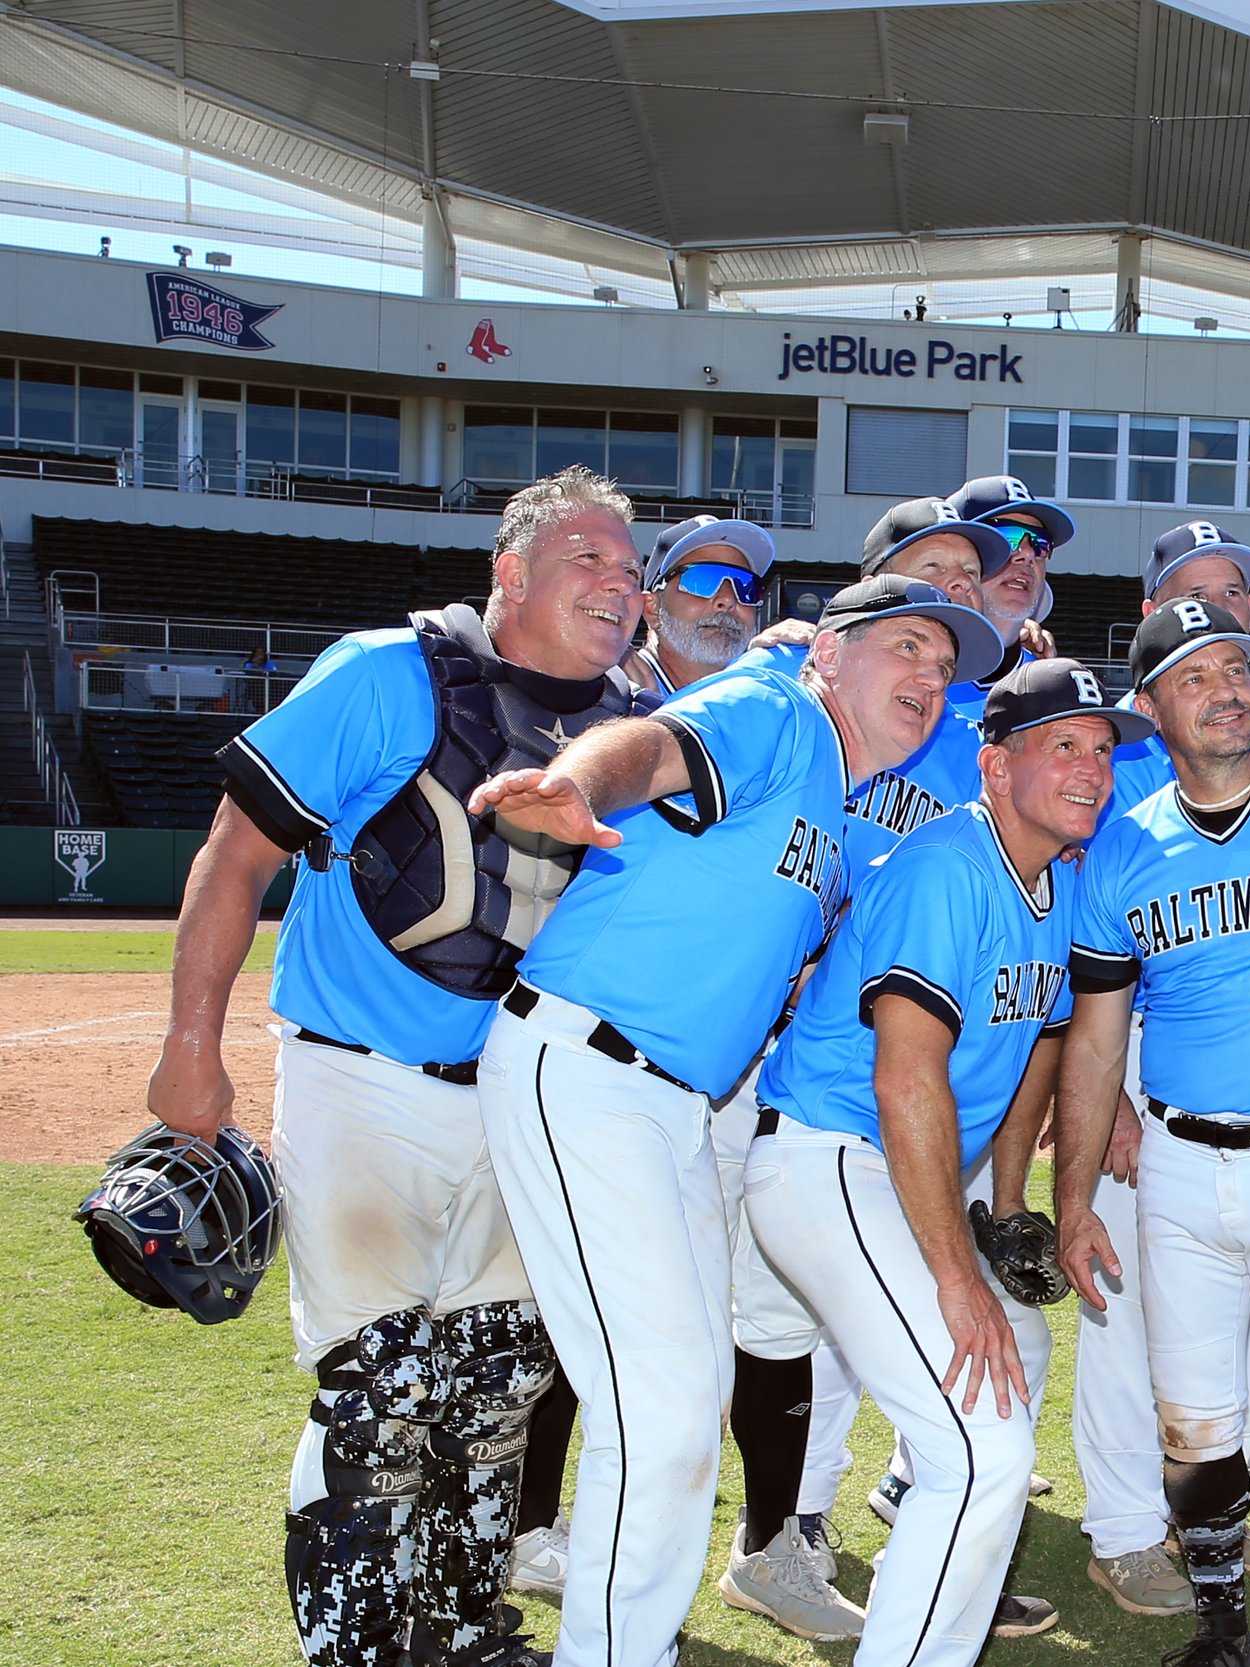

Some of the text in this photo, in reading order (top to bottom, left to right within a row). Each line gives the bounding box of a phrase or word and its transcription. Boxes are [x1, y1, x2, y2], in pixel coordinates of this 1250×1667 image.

[168, 282, 241, 310] AMERICAN LEAGUE
[166, 291, 244, 336] 1946
[173, 320, 238, 345] CHAMPIONS
[778, 332, 1023, 383] jetBlue Park
[1003, 479, 1035, 501] B
[931, 501, 962, 524] B
[1188, 521, 1222, 547] B
[1173, 601, 1212, 633] B
[1070, 670, 1103, 706] B
[59, 834, 102, 845] HOME
[63, 845, 98, 855] BASE
[468, 1428, 528, 1461] Diamond
[371, 1471, 422, 1493] Diamo
